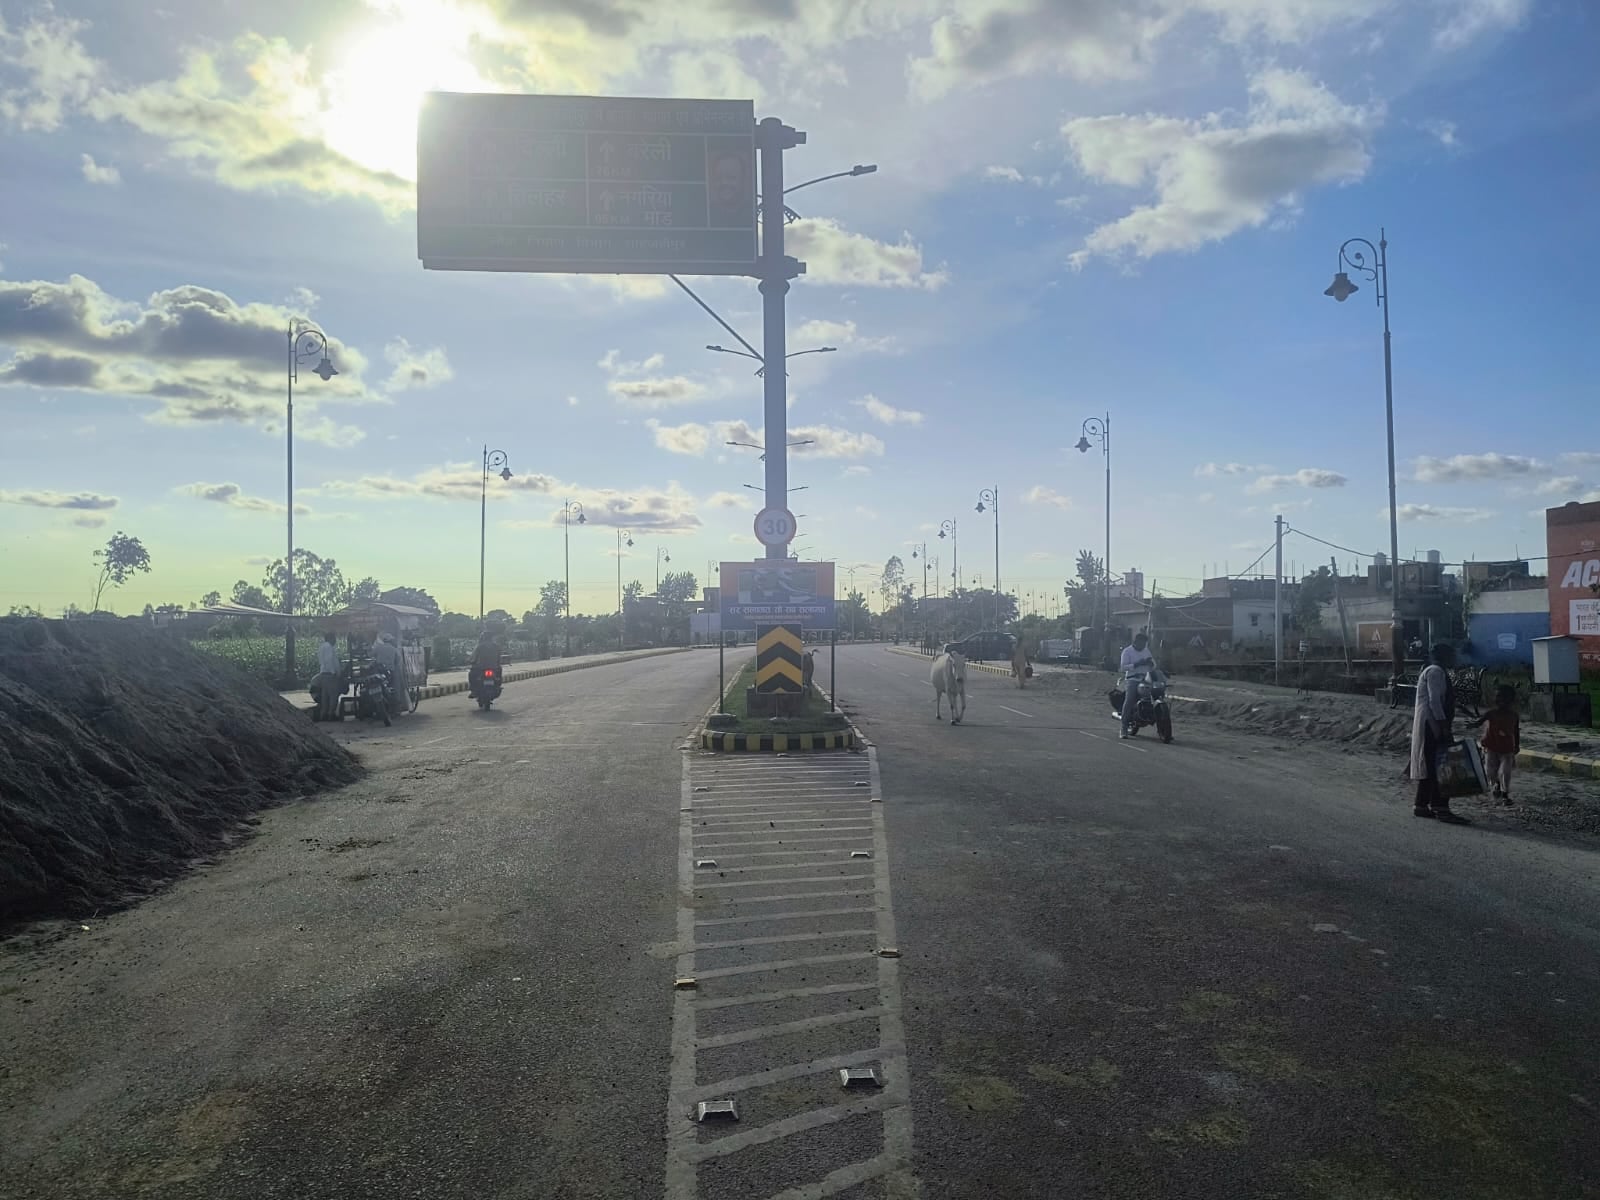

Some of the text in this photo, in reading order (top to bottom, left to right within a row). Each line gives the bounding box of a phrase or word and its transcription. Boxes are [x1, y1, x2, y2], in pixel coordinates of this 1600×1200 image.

[624, 136, 671, 160] बरेली
[615, 184, 672, 209] नगरिया
[763, 519, 787, 536] 30
